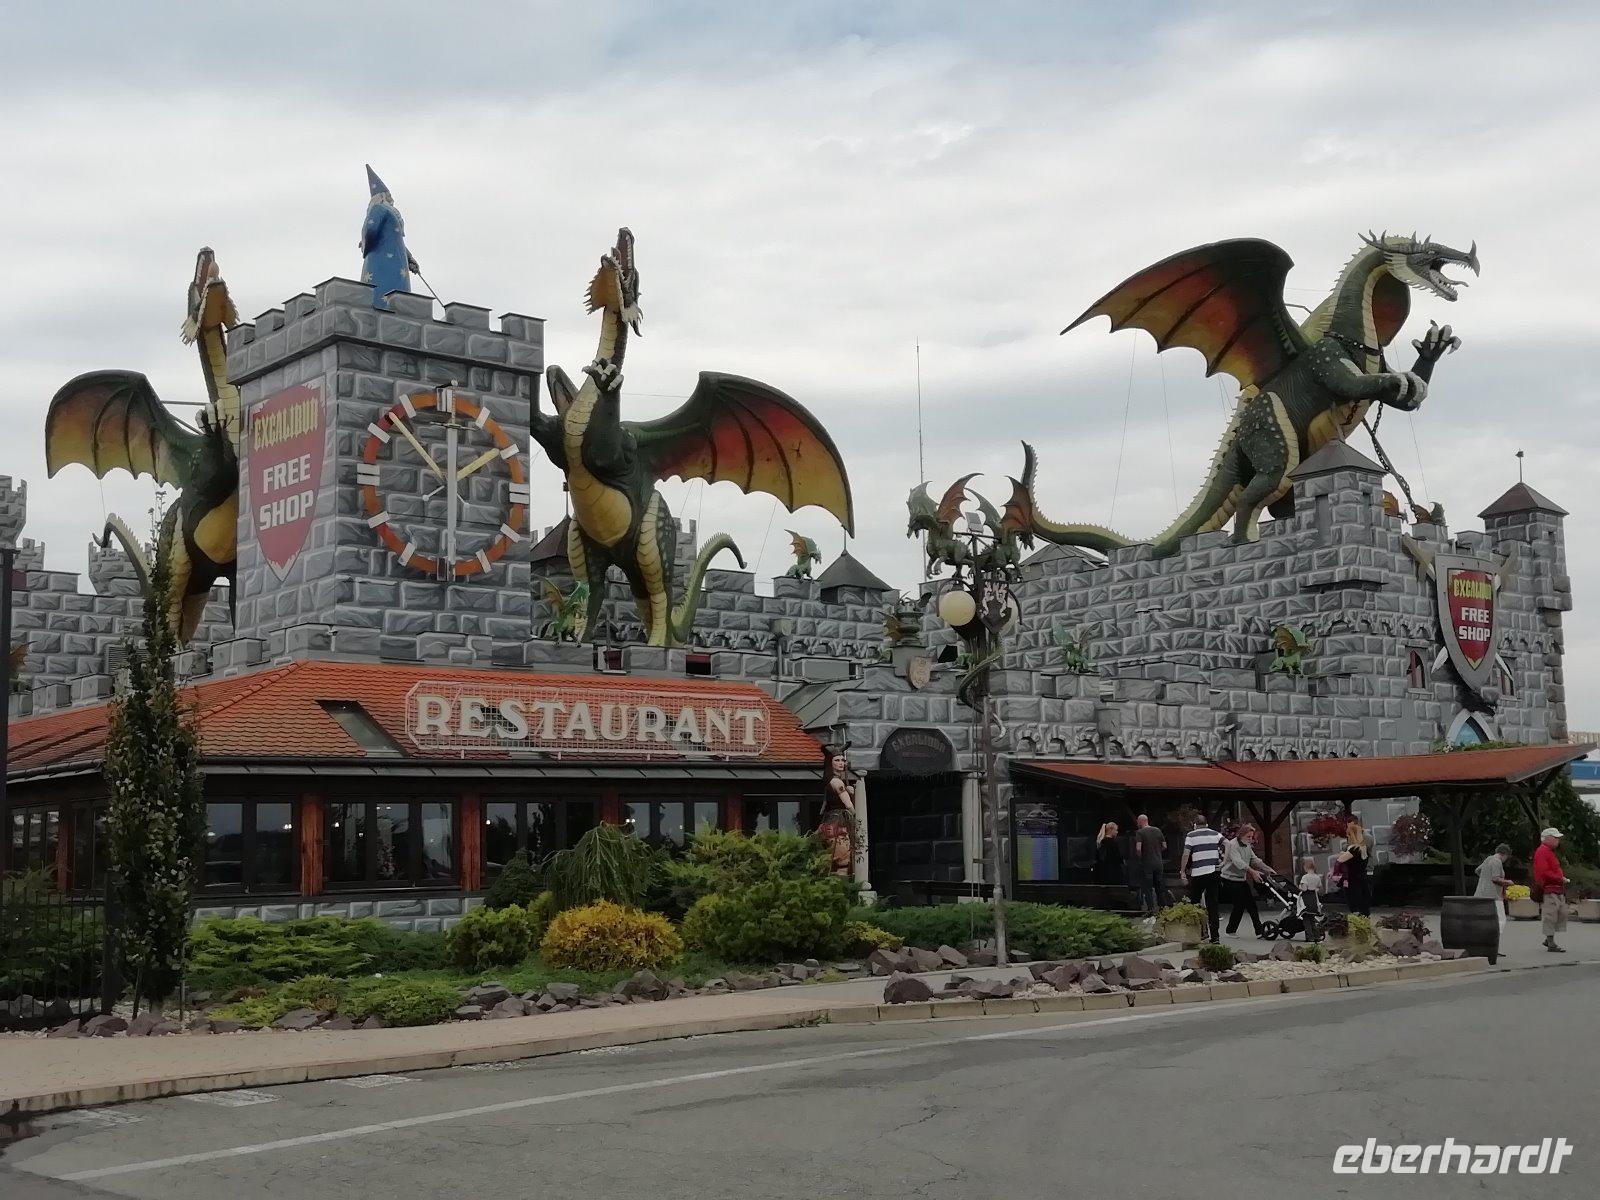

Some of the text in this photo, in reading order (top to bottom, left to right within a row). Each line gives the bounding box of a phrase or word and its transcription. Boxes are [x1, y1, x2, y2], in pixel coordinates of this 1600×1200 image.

[254, 396, 319, 451] EXCALIBUR
[263, 453, 311, 494] FREE
[259, 490, 314, 531] SHOP
[1458, 625, 1491, 642] SHOP
[1461, 607, 1490, 624] FREE
[414, 694, 765, 746] RESTAURANT
